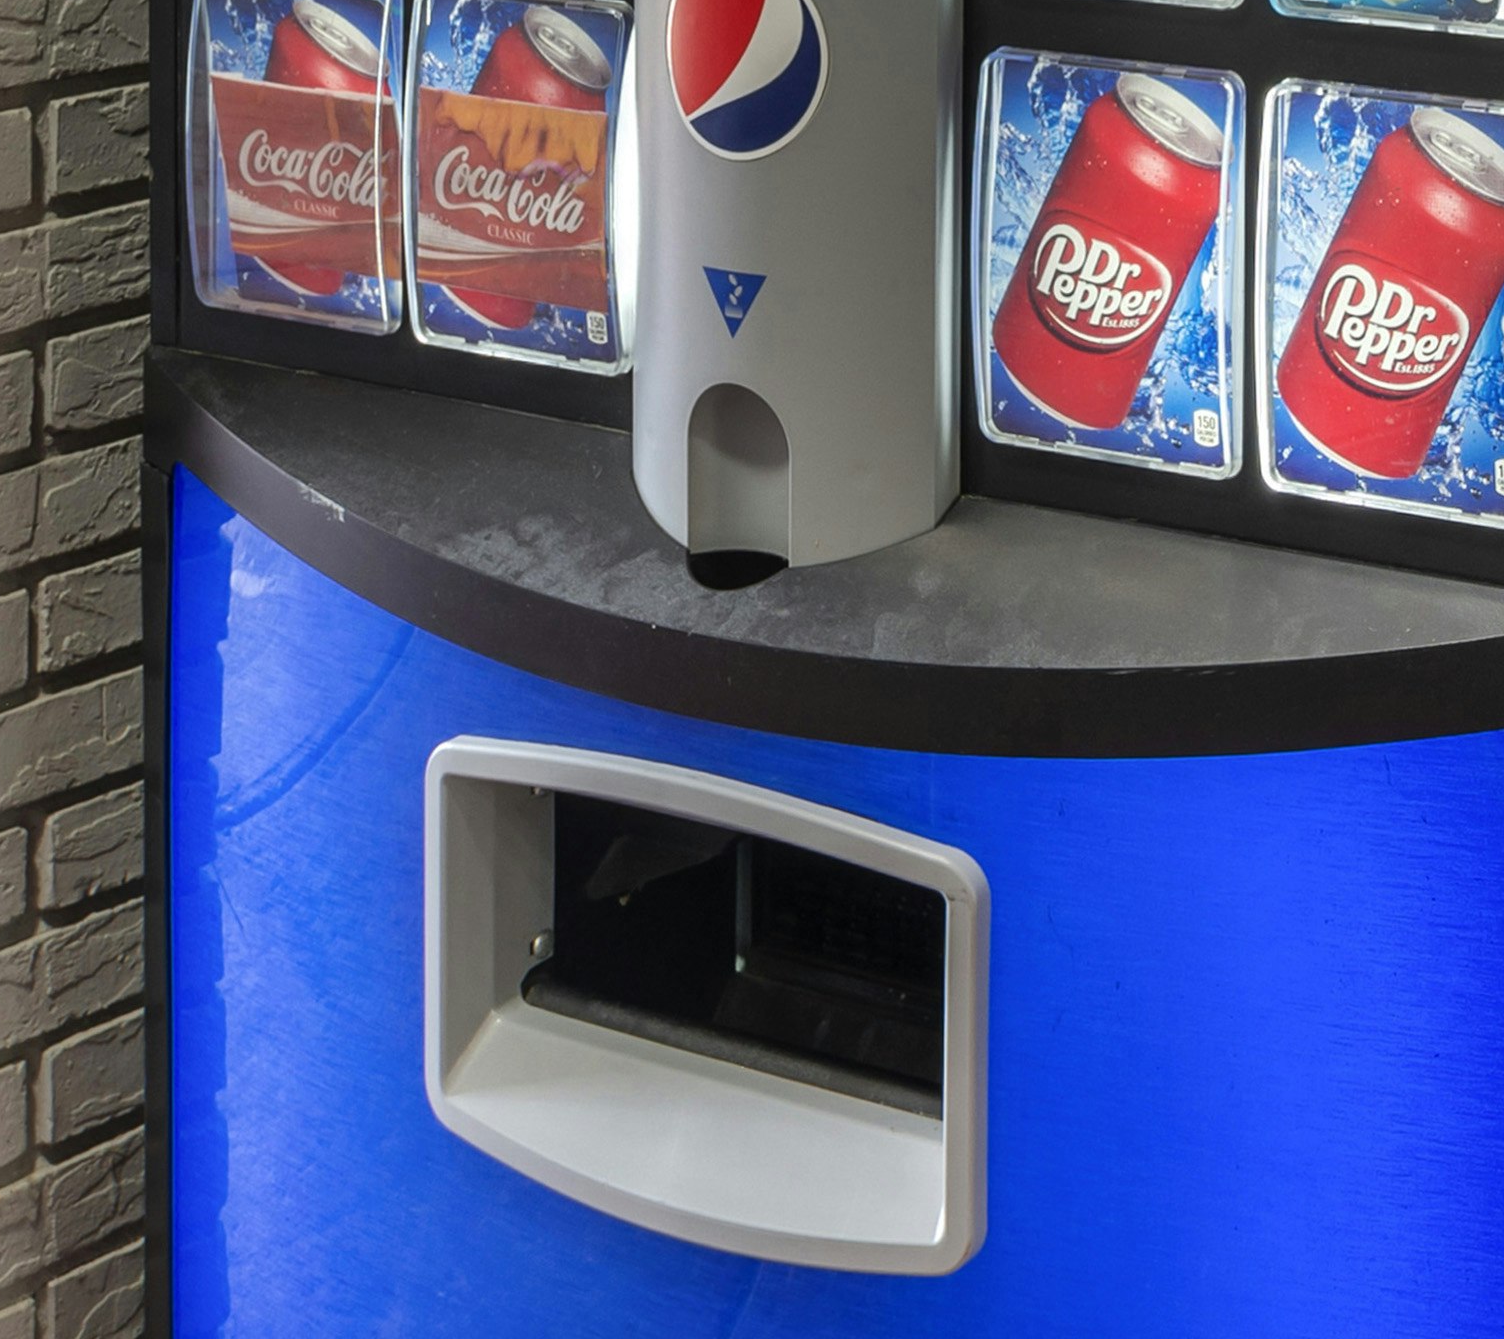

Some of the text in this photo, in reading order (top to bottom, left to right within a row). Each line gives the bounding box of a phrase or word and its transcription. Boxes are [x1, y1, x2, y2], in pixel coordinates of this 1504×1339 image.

[238, 128, 393, 210] Coca-Cola
[293, 199, 339, 219] CLASSIC
[486, 223, 535, 246] CLASSIC
[1036, 224, 1163, 327] Pepper
[1084, 239, 1142, 289] Dr
[1322, 264, 1461, 370] Pepper
[1375, 279, 1437, 333] Dr
